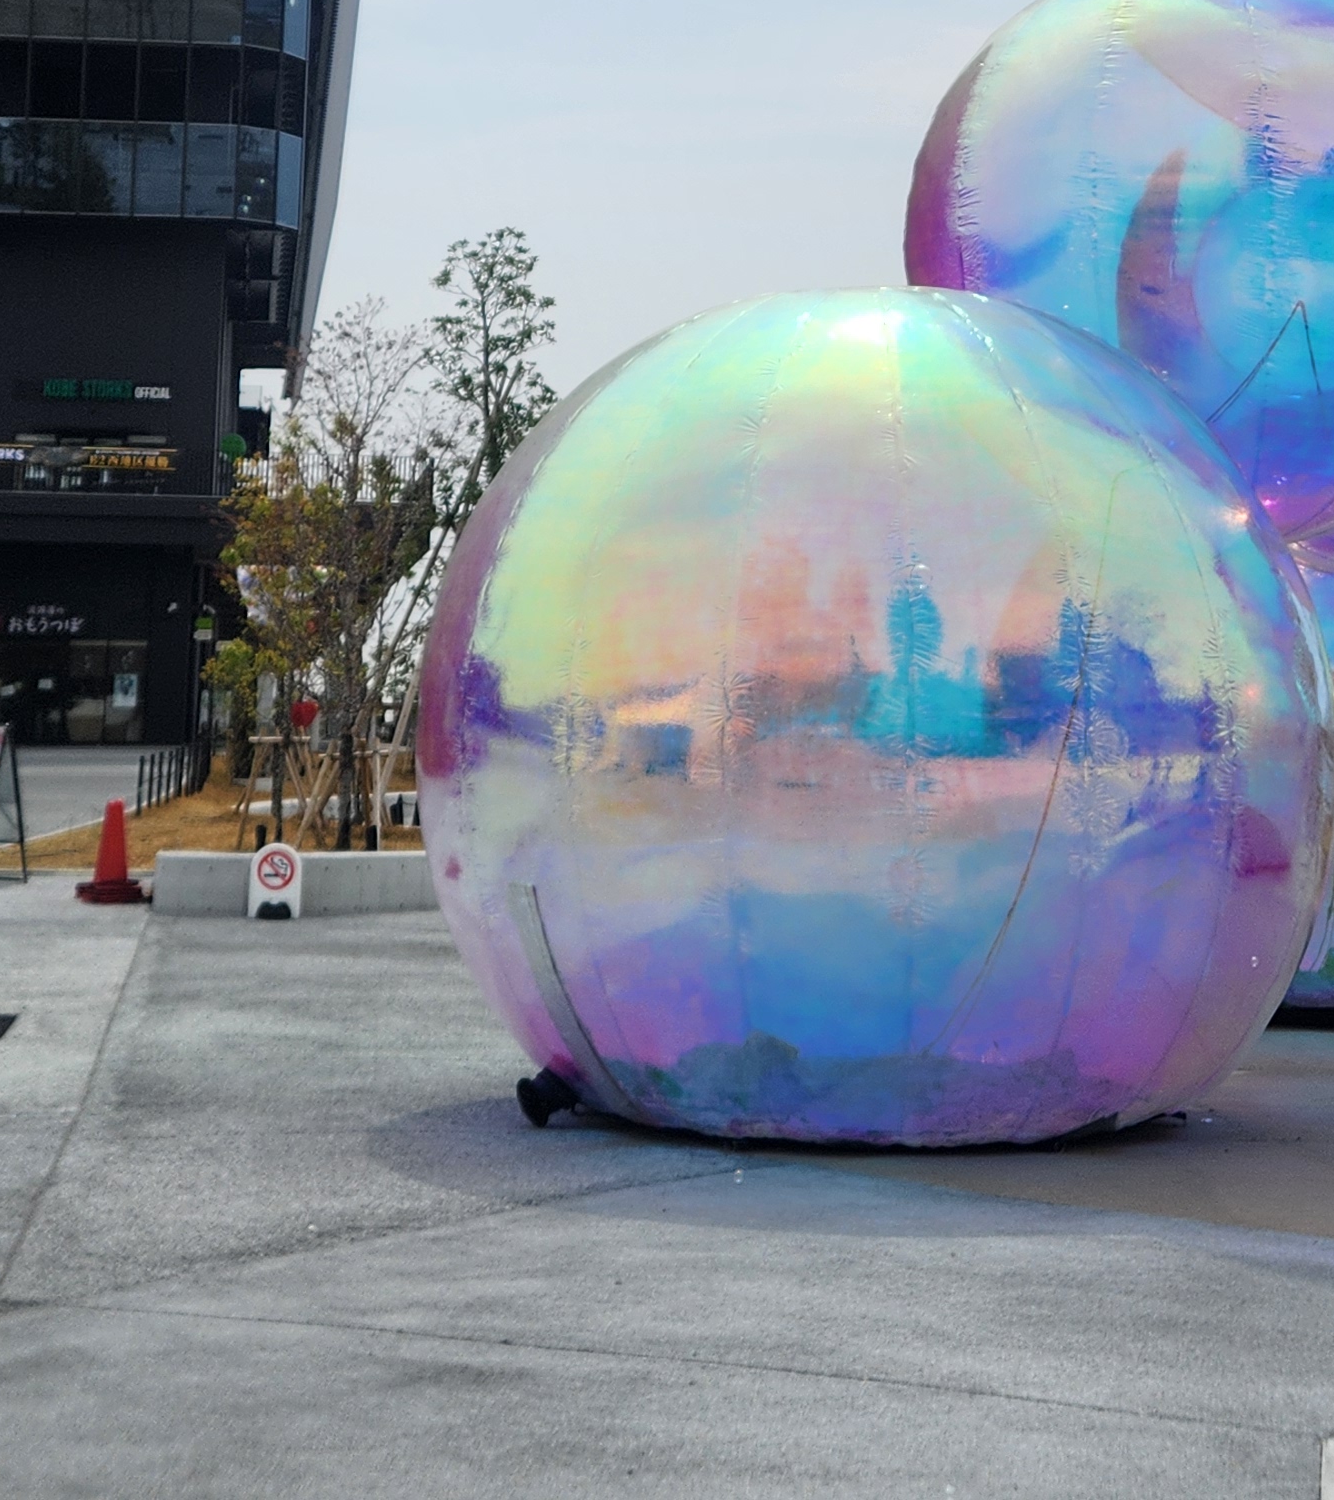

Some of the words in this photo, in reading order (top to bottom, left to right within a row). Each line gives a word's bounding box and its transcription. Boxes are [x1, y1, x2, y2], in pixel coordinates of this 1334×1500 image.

[43, 378, 77, 398] KOBE
[134, 386, 171, 400] OFFICIAL
[7, 615, 85, 633] おもうつぼ
